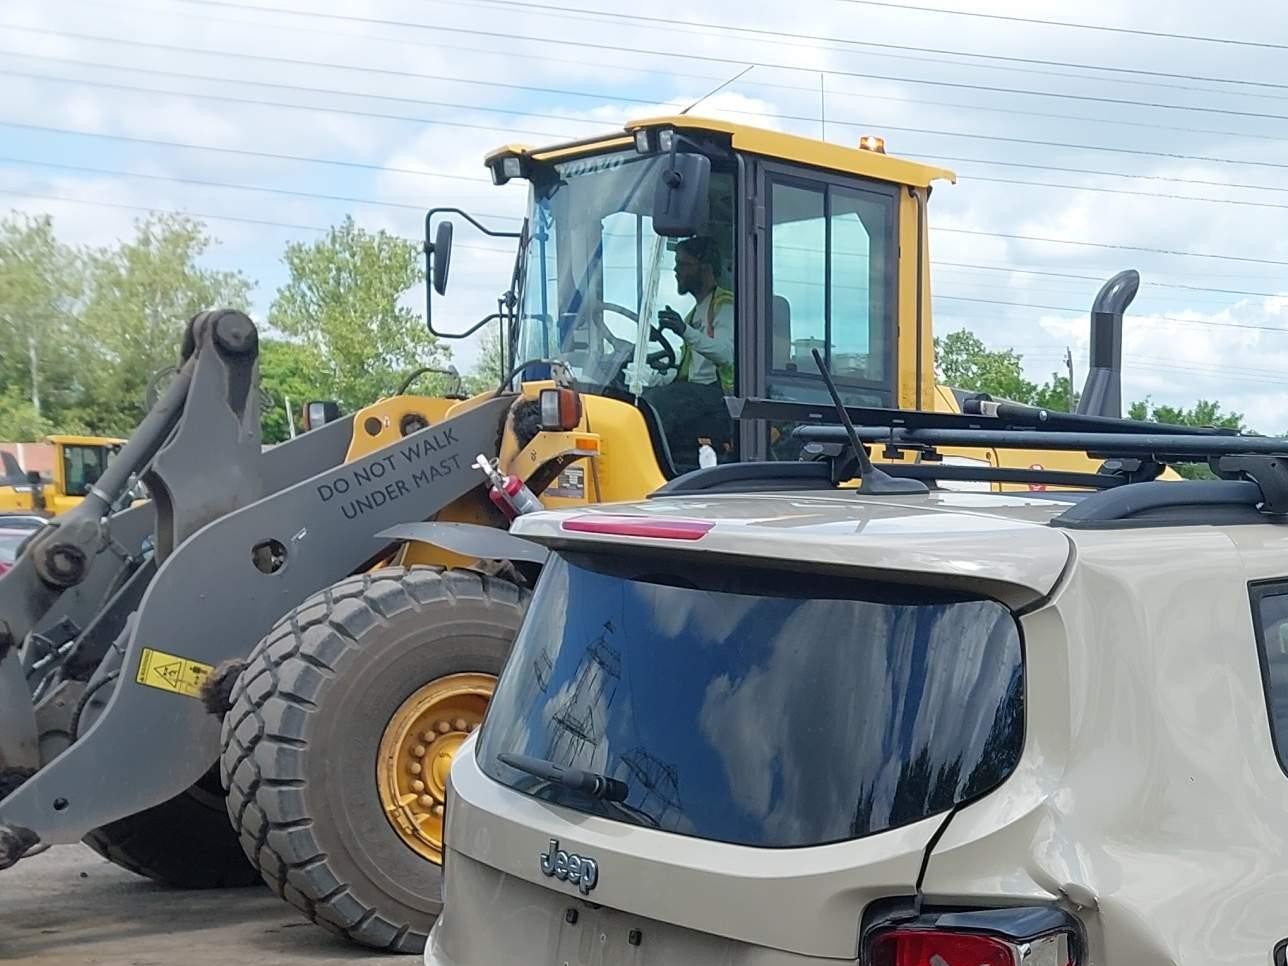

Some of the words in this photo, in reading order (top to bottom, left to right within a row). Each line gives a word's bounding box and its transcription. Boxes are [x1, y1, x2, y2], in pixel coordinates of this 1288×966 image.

[317, 478, 350, 502] DO
[353, 455, 397, 486] NOT
[400, 428, 459, 463] WALK
[341, 479, 410, 520] UNDER
[412, 454, 461, 488] MAST
[540, 838, 599, 895] Jeep
